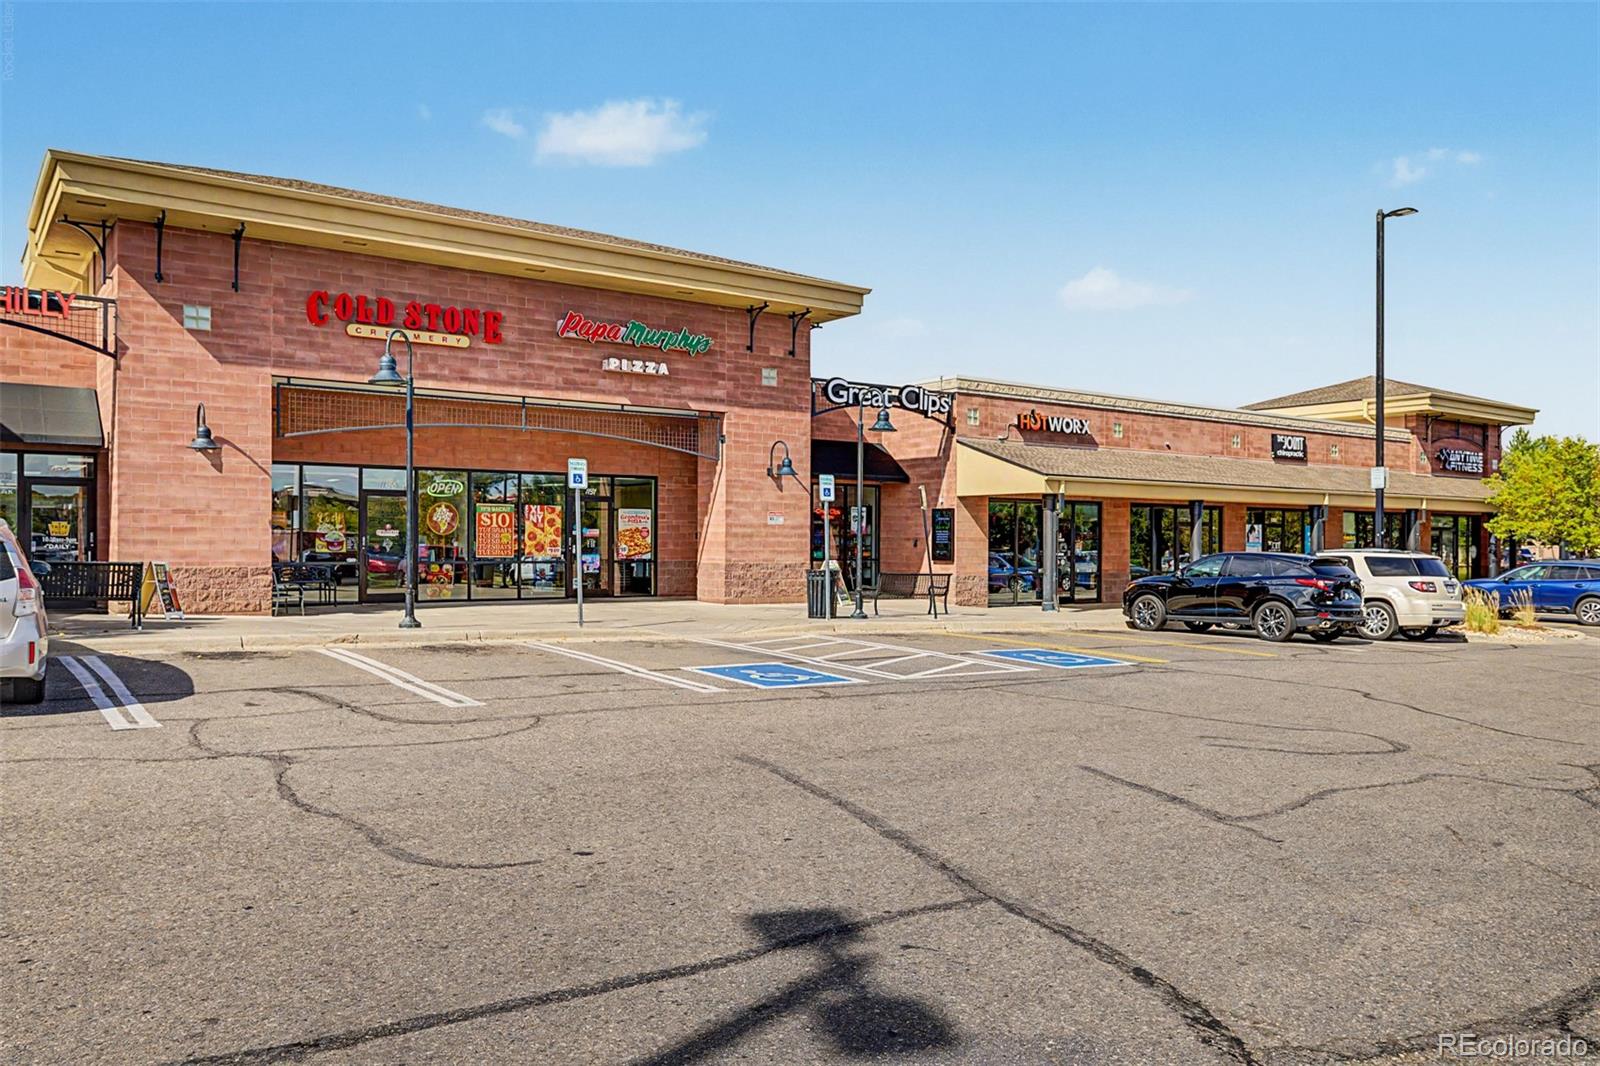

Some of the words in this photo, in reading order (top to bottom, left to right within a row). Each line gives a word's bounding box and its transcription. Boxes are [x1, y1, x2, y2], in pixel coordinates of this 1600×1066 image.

[306, 290, 396, 326] COLD
[403, 300, 503, 344] STONE
[557, 310, 622, 343] Papa
[623, 320, 714, 356] Murphy's
[608, 357, 669, 375] PIZZA
[827, 378, 895, 408] Great
[901, 386, 950, 418] Clips
[1449, 462, 1483, 473] FITNESS
[430, 482, 460, 494] OPEN
[481, 512, 510, 528] $10
